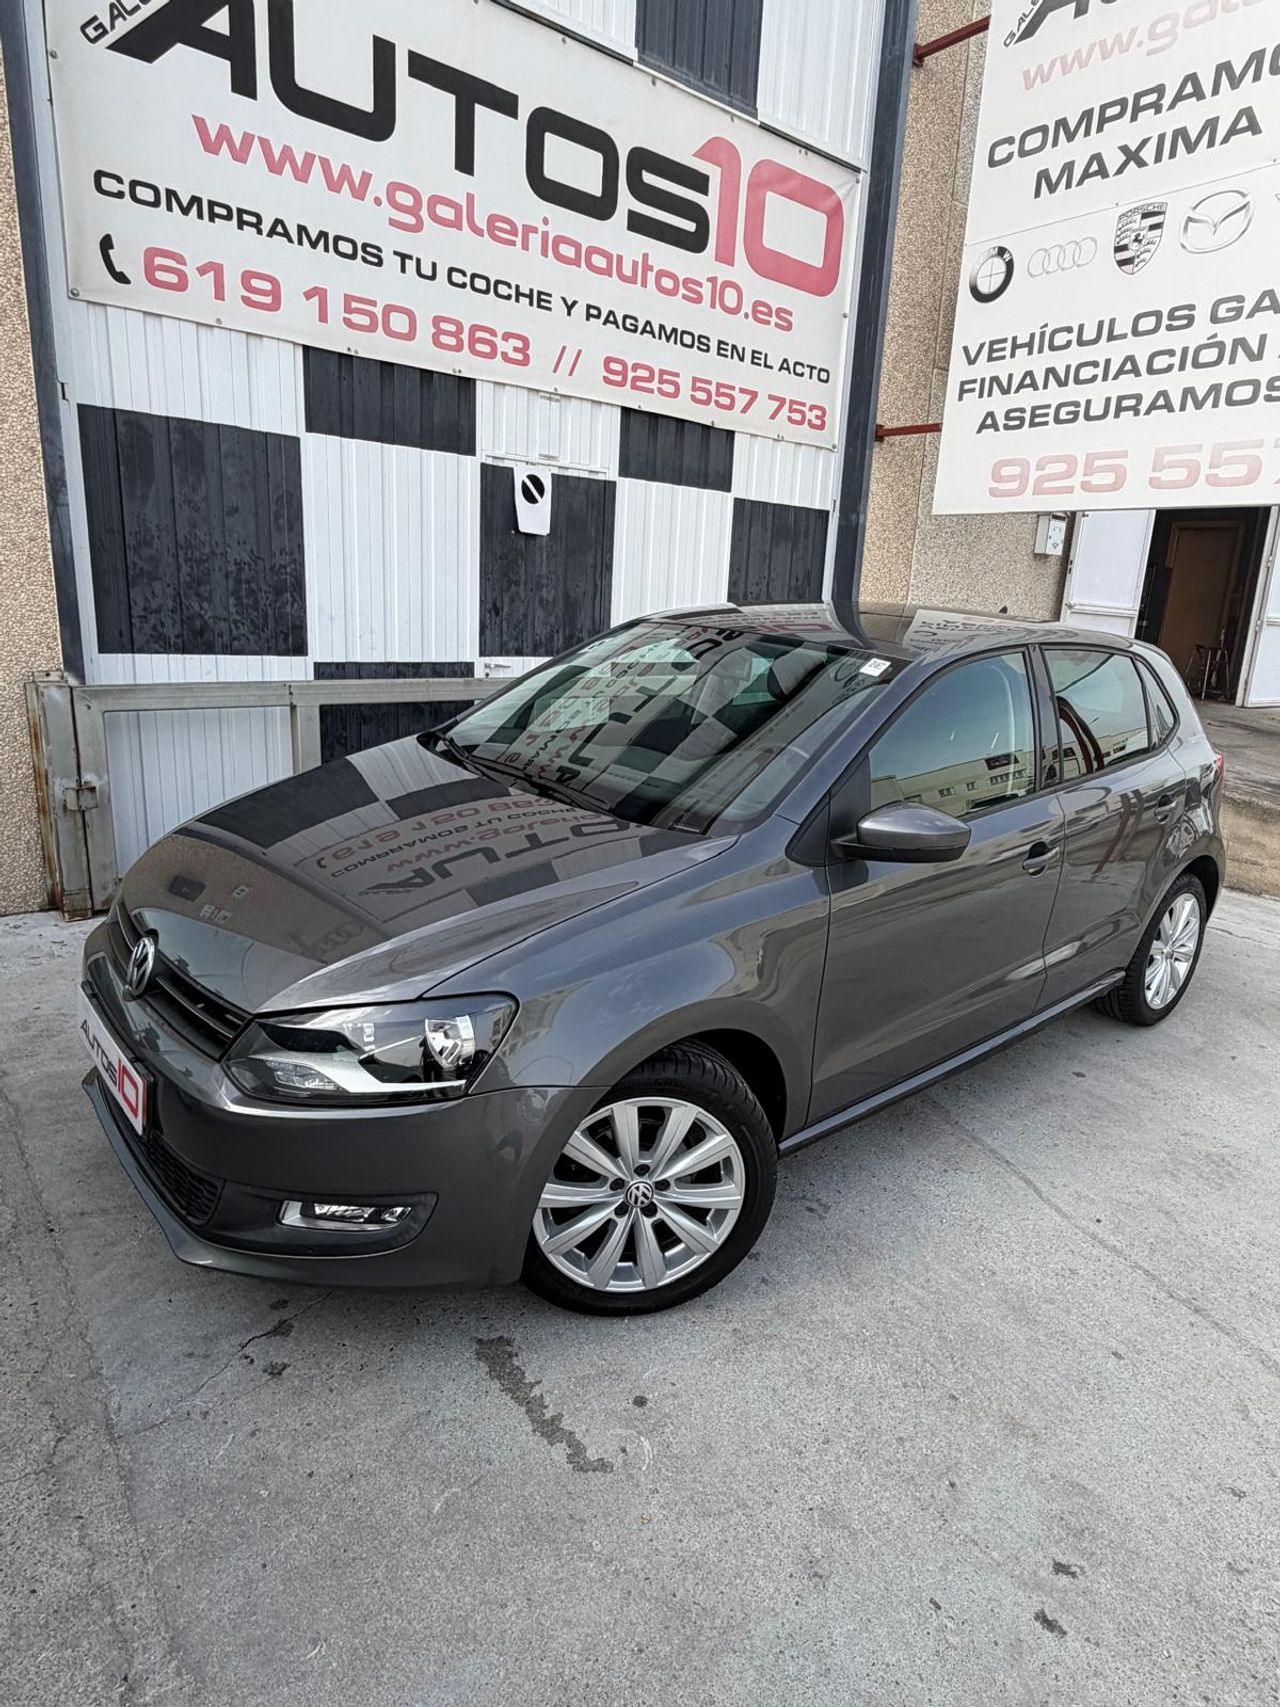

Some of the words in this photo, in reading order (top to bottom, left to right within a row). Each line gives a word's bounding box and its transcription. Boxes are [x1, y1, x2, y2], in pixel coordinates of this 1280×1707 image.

[1034, 106, 1263, 199] MAXIMA
[192, 114, 793, 333] www.galeriaautos10.es
[93, 169, 383, 268] COMPRAMOS
[393, 250, 438, 282] TU
[447, 266, 553, 312] COCHE
[560, 296, 579, 317] Y
[585, 304, 711, 357] PAGAMOS
[716, 340, 746, 364] EN
[750, 350, 774, 370] EL
[778, 357, 831, 384] ACTO
[143, 246, 283, 313] 619
[302, 286, 417, 342] 150
[431, 314, 532, 368] 863
[602, 356, 681, 400] 925
[690, 378, 759, 415] 557
[767, 393, 827, 431] 753
[956, 333, 1268, 402] FINANCIACIÓN
[962, 303, 1197, 366] VEHÍCULOS
[987, 450, 1129, 498] 925
[80, 1018, 139, 1119] AUTOS10
